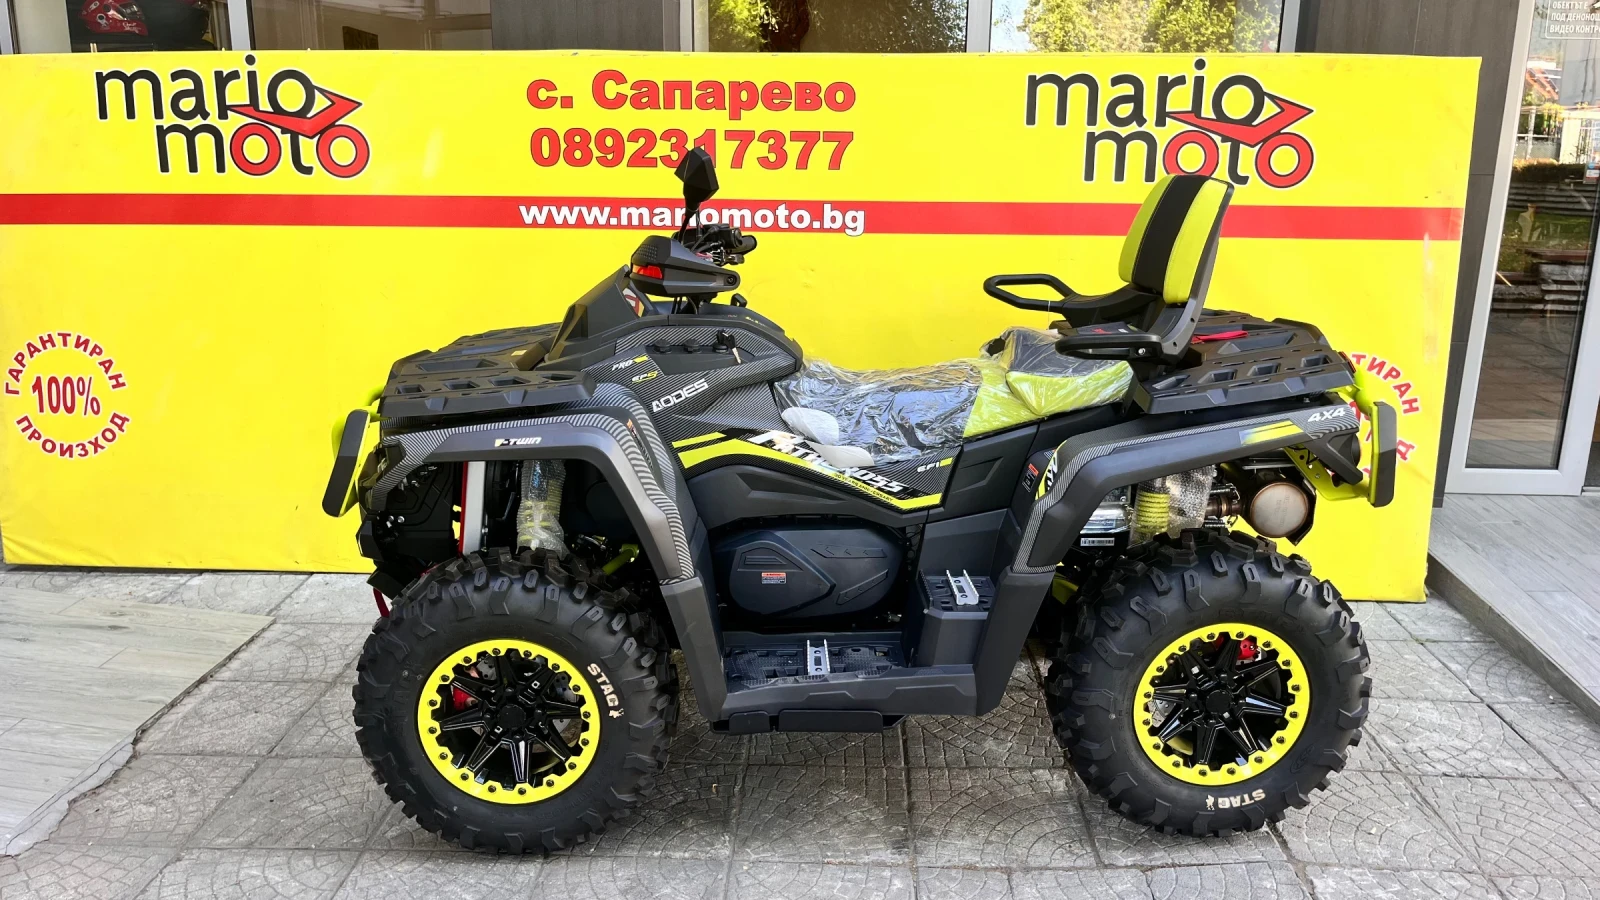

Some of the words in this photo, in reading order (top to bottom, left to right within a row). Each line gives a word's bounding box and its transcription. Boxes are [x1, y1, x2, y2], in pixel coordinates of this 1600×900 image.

[1549, 24, 1574, 35] ВИДЕО
[1575, 25, 1600, 34] КОНТР
[1550, 12, 1566, 22] ПОД
[95, 54, 316, 121] mario
[592, 69, 856, 121] Сапарево
[1025, 58, 1265, 128] mario
[155, 122, 370, 178] moto
[530, 128, 854, 170] 0892317377
[5, 332, 127, 395] ГАРАНТИРАН
[32, 375, 101, 416] 100%
[652, 378, 709, 413] AODES
[15, 412, 130, 459] ПРОИЗХОД
[587, 663, 619, 707] STAG
[1217, 788, 1266, 809] STAG
